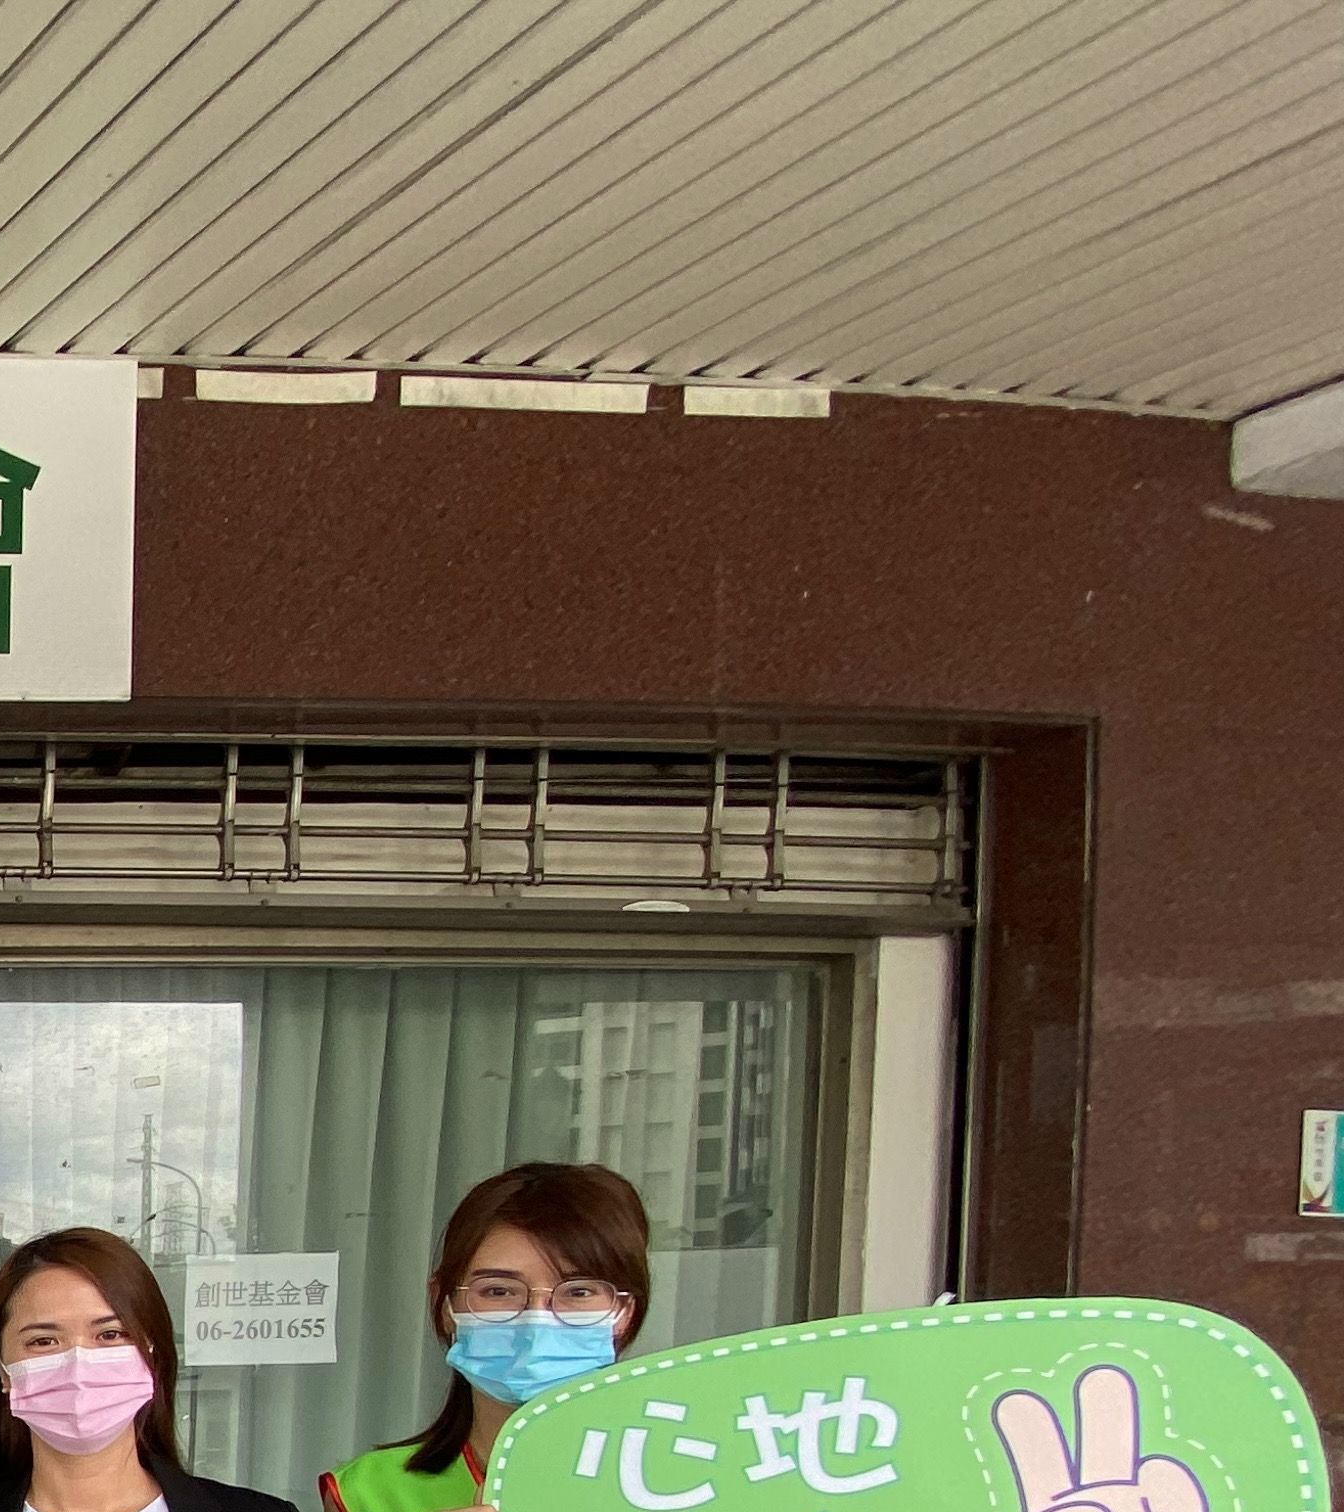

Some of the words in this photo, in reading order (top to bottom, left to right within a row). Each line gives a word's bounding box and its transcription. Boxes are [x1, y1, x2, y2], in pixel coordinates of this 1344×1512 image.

[195, 1279, 330, 1309] 創世基金會
[196, 1317, 326, 1342] 06-2601655
[574, 1376, 899, 1512] 心地
